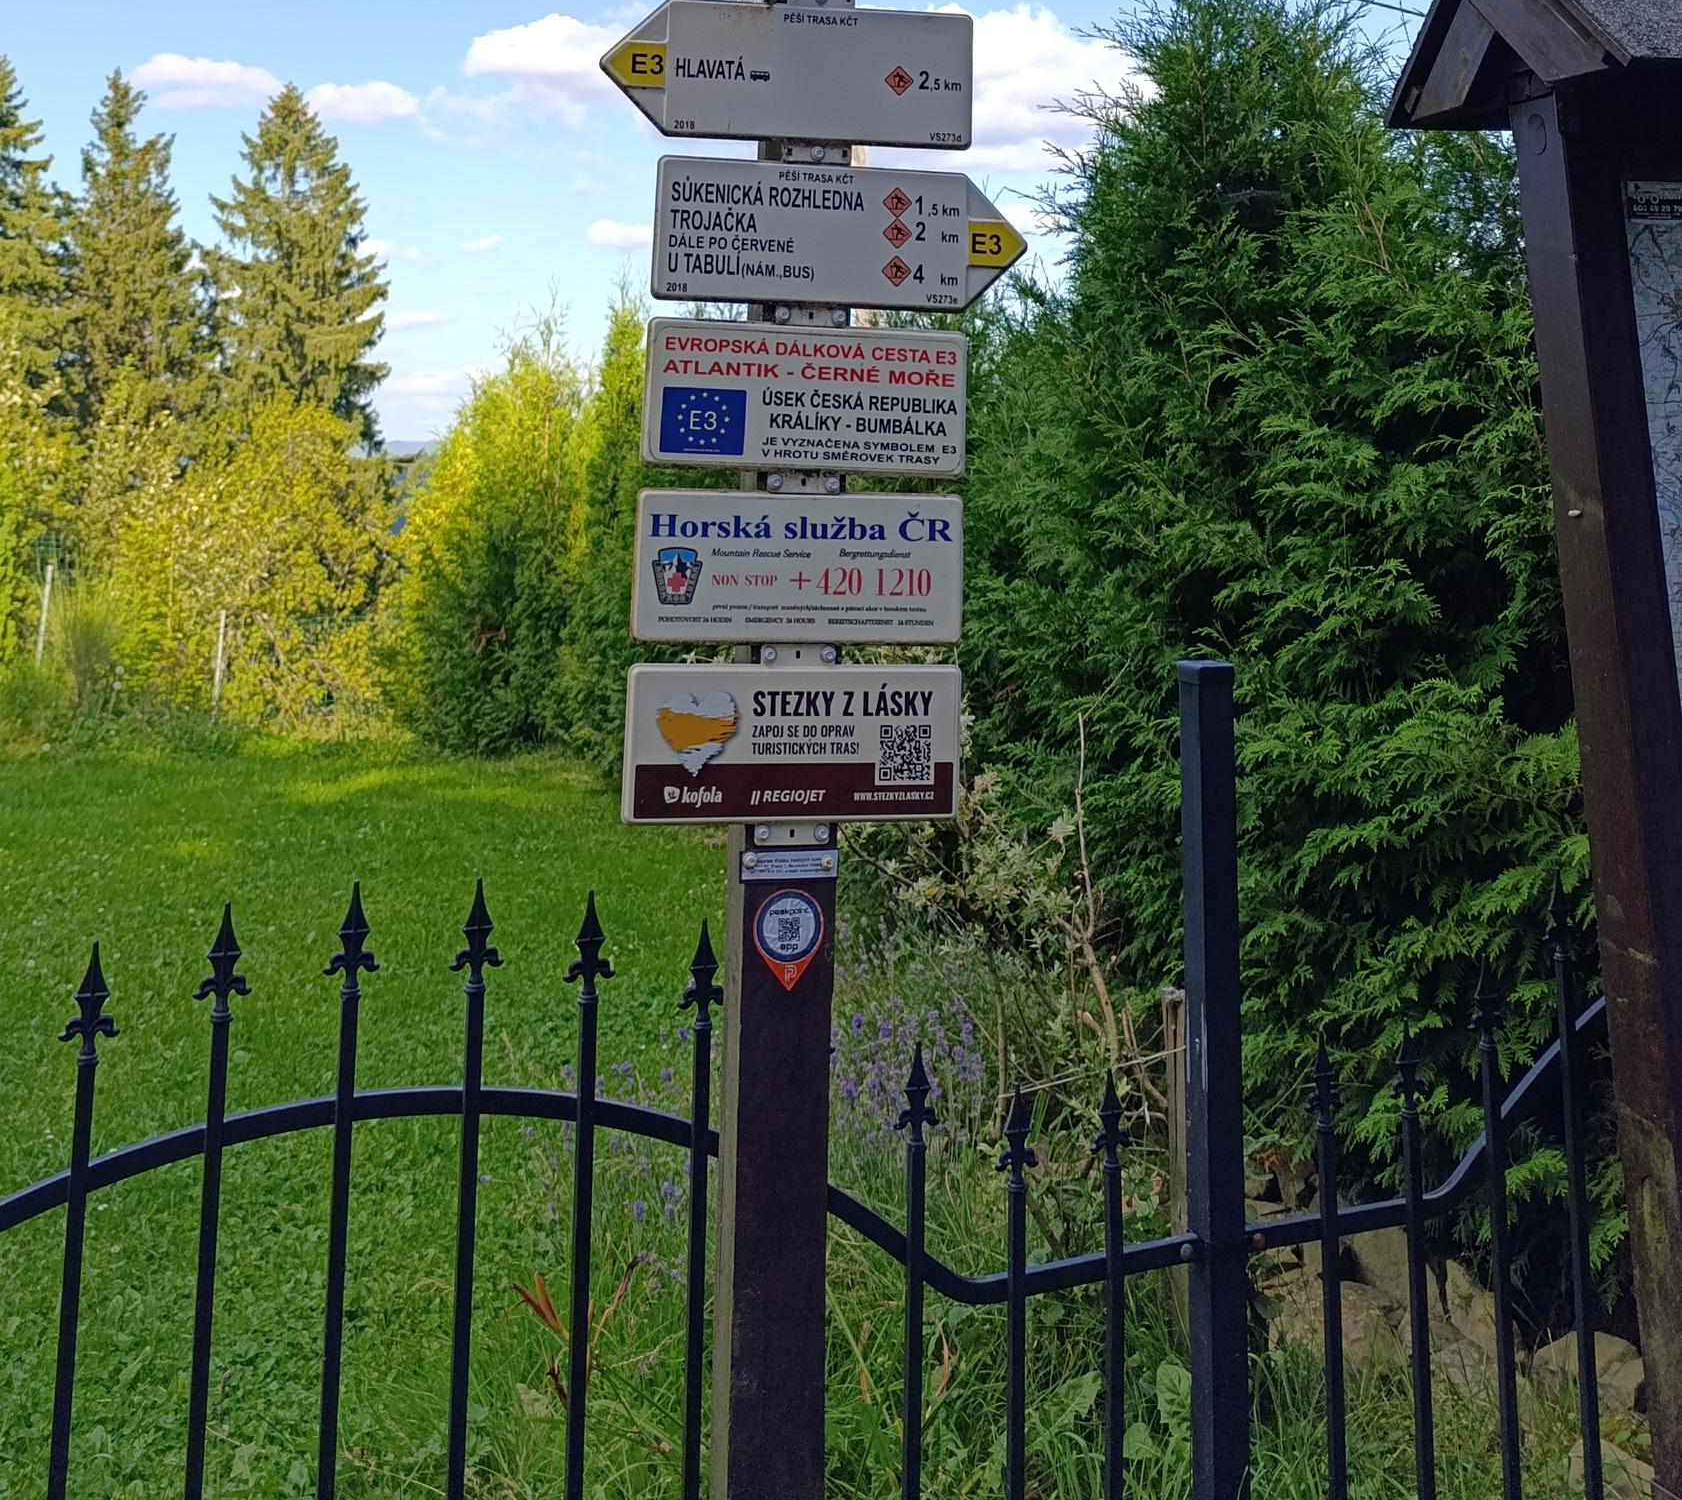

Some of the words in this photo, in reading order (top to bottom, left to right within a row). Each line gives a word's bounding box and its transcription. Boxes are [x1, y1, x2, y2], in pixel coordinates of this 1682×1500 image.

[783, 13, 805, 24] PĚŠÍ
[807, 14, 838, 26] TRASA
[839, 15, 858, 27] KČT
[631, 53, 664, 76] E3
[675, 56, 745, 81] HLAVATÁ
[943, 79, 962, 92] km
[674, 120, 695, 130] 2018
[929, 132, 962, 143] VS273d
[779, 171, 800, 182] PĚŠÍ
[802, 173, 833, 184] TRASA
[836, 174, 855, 185] KČT
[671, 175, 764, 206] SŮKENICKÁ
[769, 187, 865, 212] ROZHLEDNA
[941, 205, 960, 217] km
[671, 207, 757, 233] TROJAČKA
[915, 222, 926, 242] 2
[941, 232, 959, 244] km
[669, 233, 704, 250] DÁLE
[708, 236, 728, 250] PO
[731, 235, 795, 253] ČERVENÉ
[971, 234, 1002, 255] E3
[668, 253, 679, 272] U
[913, 264, 925, 284] 4
[940, 274, 958, 286] km
[666, 282, 688, 293] 2018
[665, 334, 769, 355] EVROPSKÁ
[775, 339, 864, 360] DÁLKOVÁ
[871, 347, 931, 364] CESTA
[935, 350, 957, 365] E3
[663, 359, 779, 379] ATLANTIK
[801, 363, 880, 384] ČERNÉ
[888, 368, 956, 388] MOŘE
[762, 386, 805, 408] ÚSEK
[810, 389, 864, 411] ČESKÁ
[869, 395, 958, 415] REPUBLIKA
[689, 410, 718, 430] E3
[769, 411, 842, 432] KRÁLÍKY
[855, 415, 947, 437] BUMBÁLKA
[762, 436, 777, 446] JE
[781, 436, 860, 450] VYZNAČENA
[863, 441, 935, 453] SYMBOLEM
[942, 444, 957, 454] E3
[761, 448, 771, 458] V
[774, 449, 819, 460] HROTU
[822, 449, 894, 463] SMĚROVEK
[898, 454, 940, 465] TRASY
[649, 512, 772, 539] Horská
[784, 515, 887, 541] služba
[898, 511, 953, 542] ČR
[711, 548, 750, 558] Mountain
[752, 549, 781, 558] Rescue
[783, 549, 811, 559] Service
[839, 548, 911, 559] Bergrettungsdienst
[711, 574, 738, 586] NON
[744, 574, 778, 587] STOP
[875, 568, 932, 597] 1210
[753, 690, 835, 717] STEZKY
[843, 692, 854, 717] Z
[863, 683, 933, 717] LÁSKY
[752, 725, 784, 738] ZAPOJ
[788, 726, 799, 737] SE
[803, 726, 817, 737] DO
[821, 725, 855, 737] OPRAV
[752, 739, 826, 755] TURISTICKÝCH
[829, 742, 859, 755] TRAS!
[681, 786, 722, 808] kofola
[780, 944, 799, 952] app
